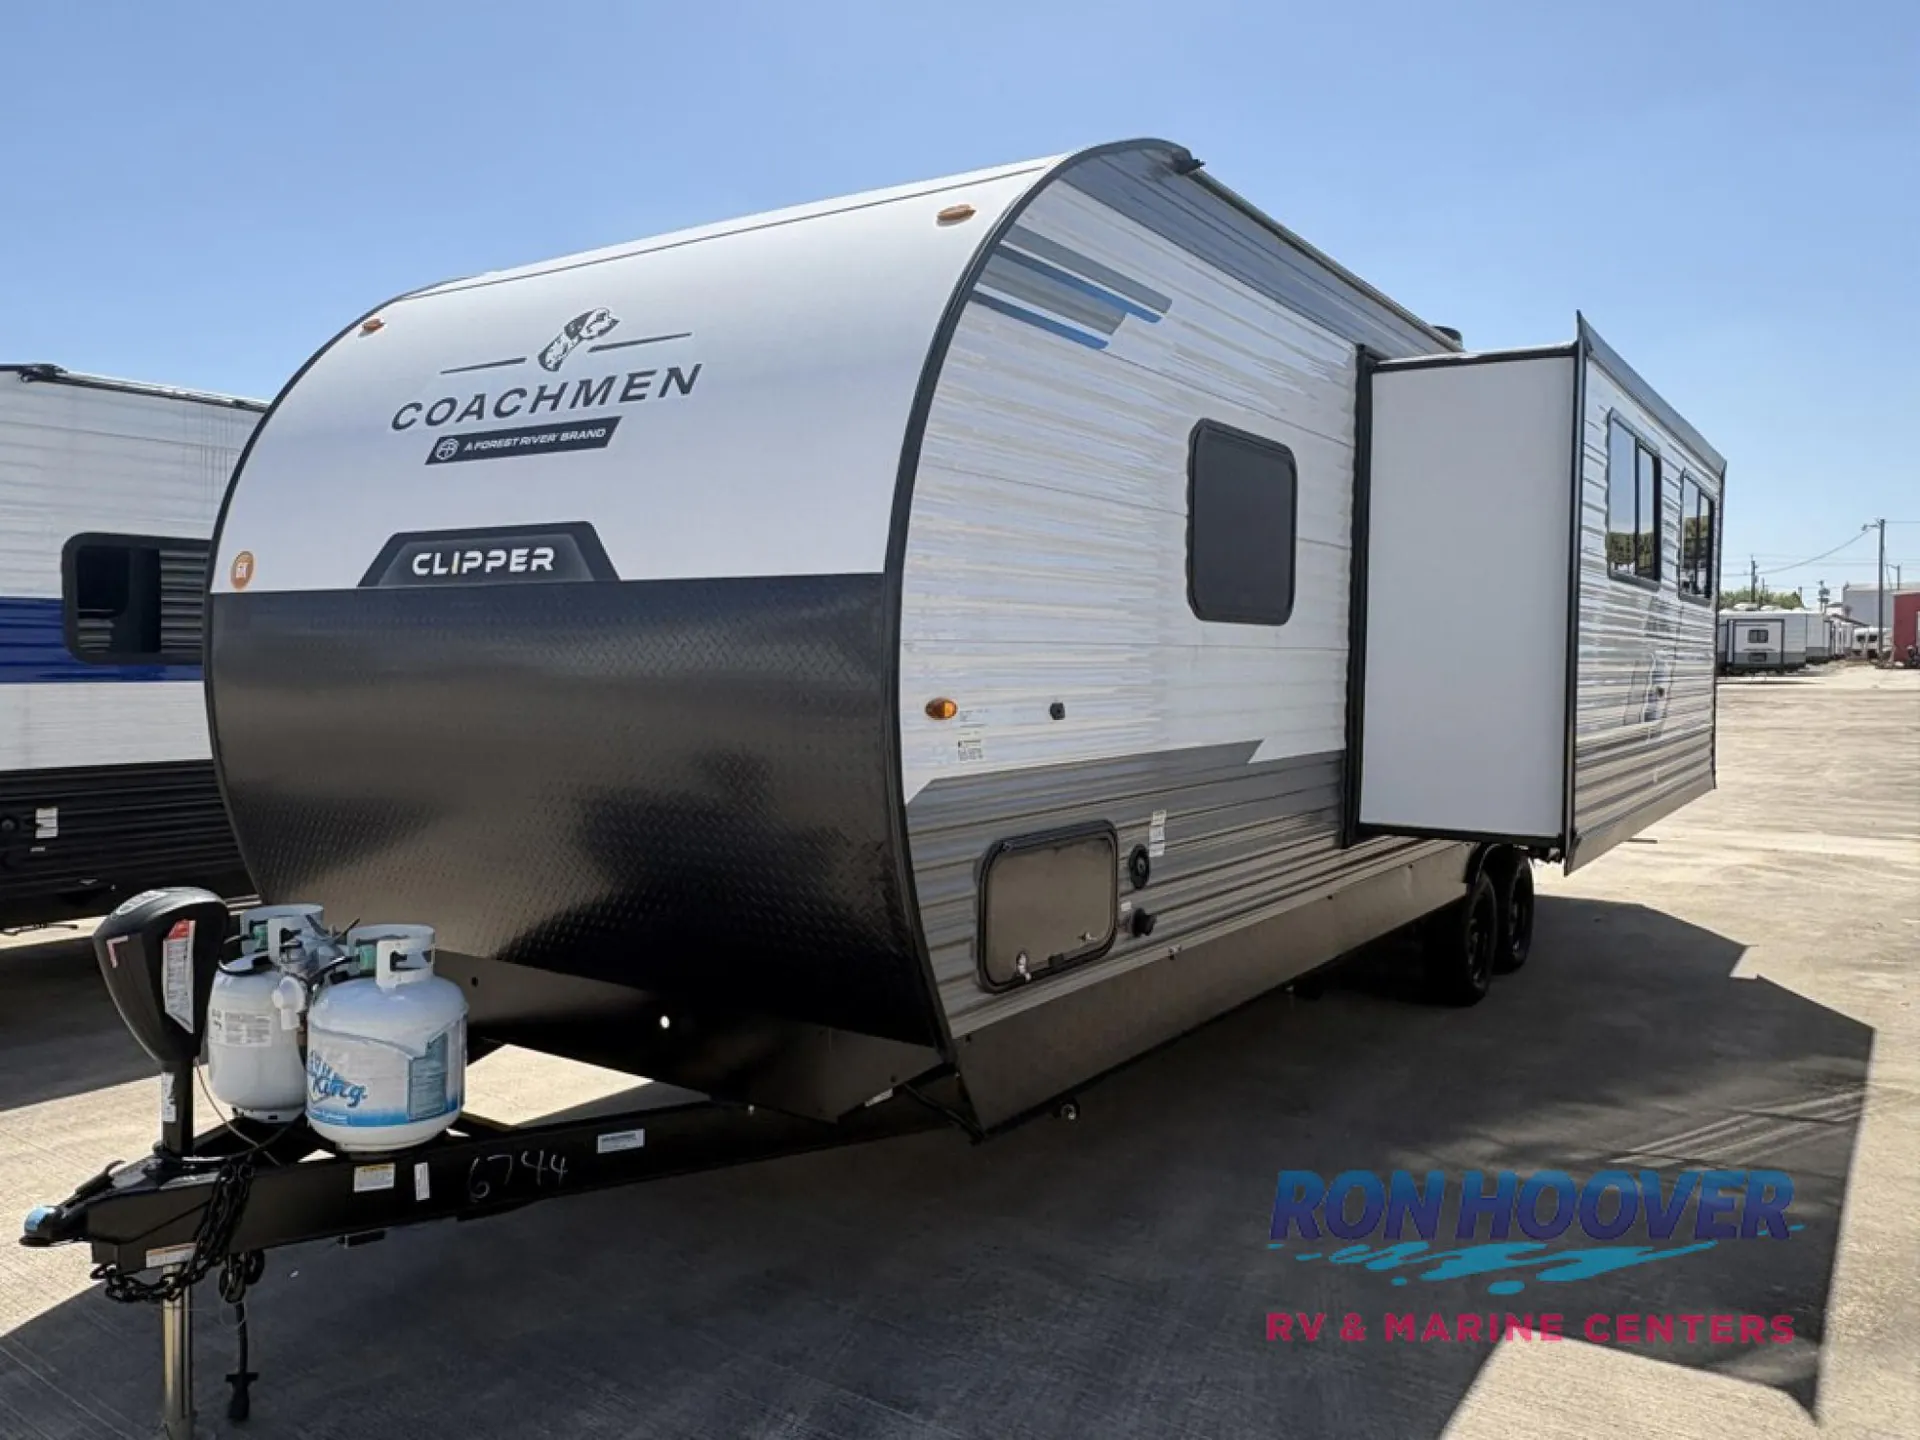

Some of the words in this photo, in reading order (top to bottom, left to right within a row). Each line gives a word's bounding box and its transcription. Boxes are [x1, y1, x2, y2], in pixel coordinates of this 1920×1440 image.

[391, 363, 702, 431] COACHMEN
[474, 437, 518, 450] FOREST
[560, 428, 606, 442] BRAND
[411, 547, 555, 576] CLIPPER
[467, 1149, 569, 1202] 6744
